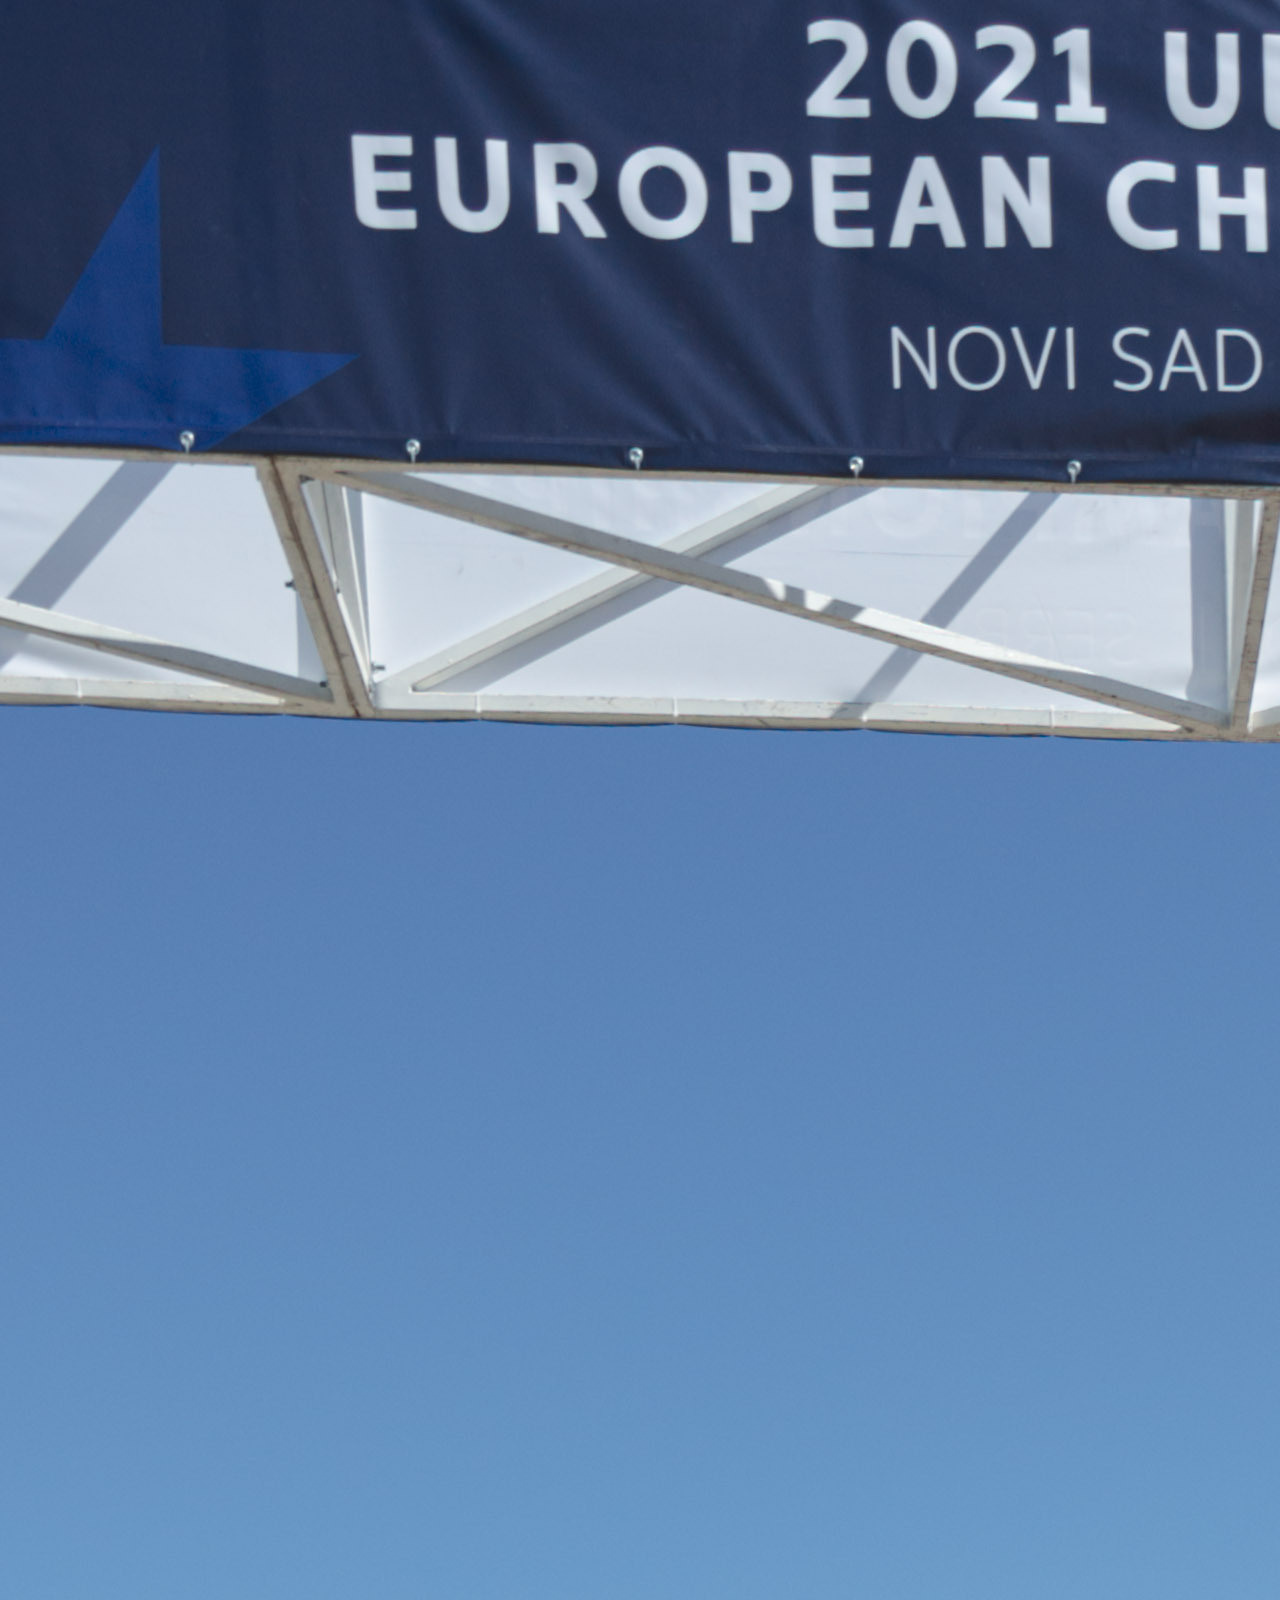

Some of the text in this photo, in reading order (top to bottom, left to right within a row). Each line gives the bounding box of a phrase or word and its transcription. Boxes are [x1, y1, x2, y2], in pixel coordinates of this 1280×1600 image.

[806, 19, 1107, 124] 2021
[351, 134, 1053, 249] EUROPEAN
[891, 326, 1076, 391] NOVI
[1112, 327, 1263, 393] SAD
